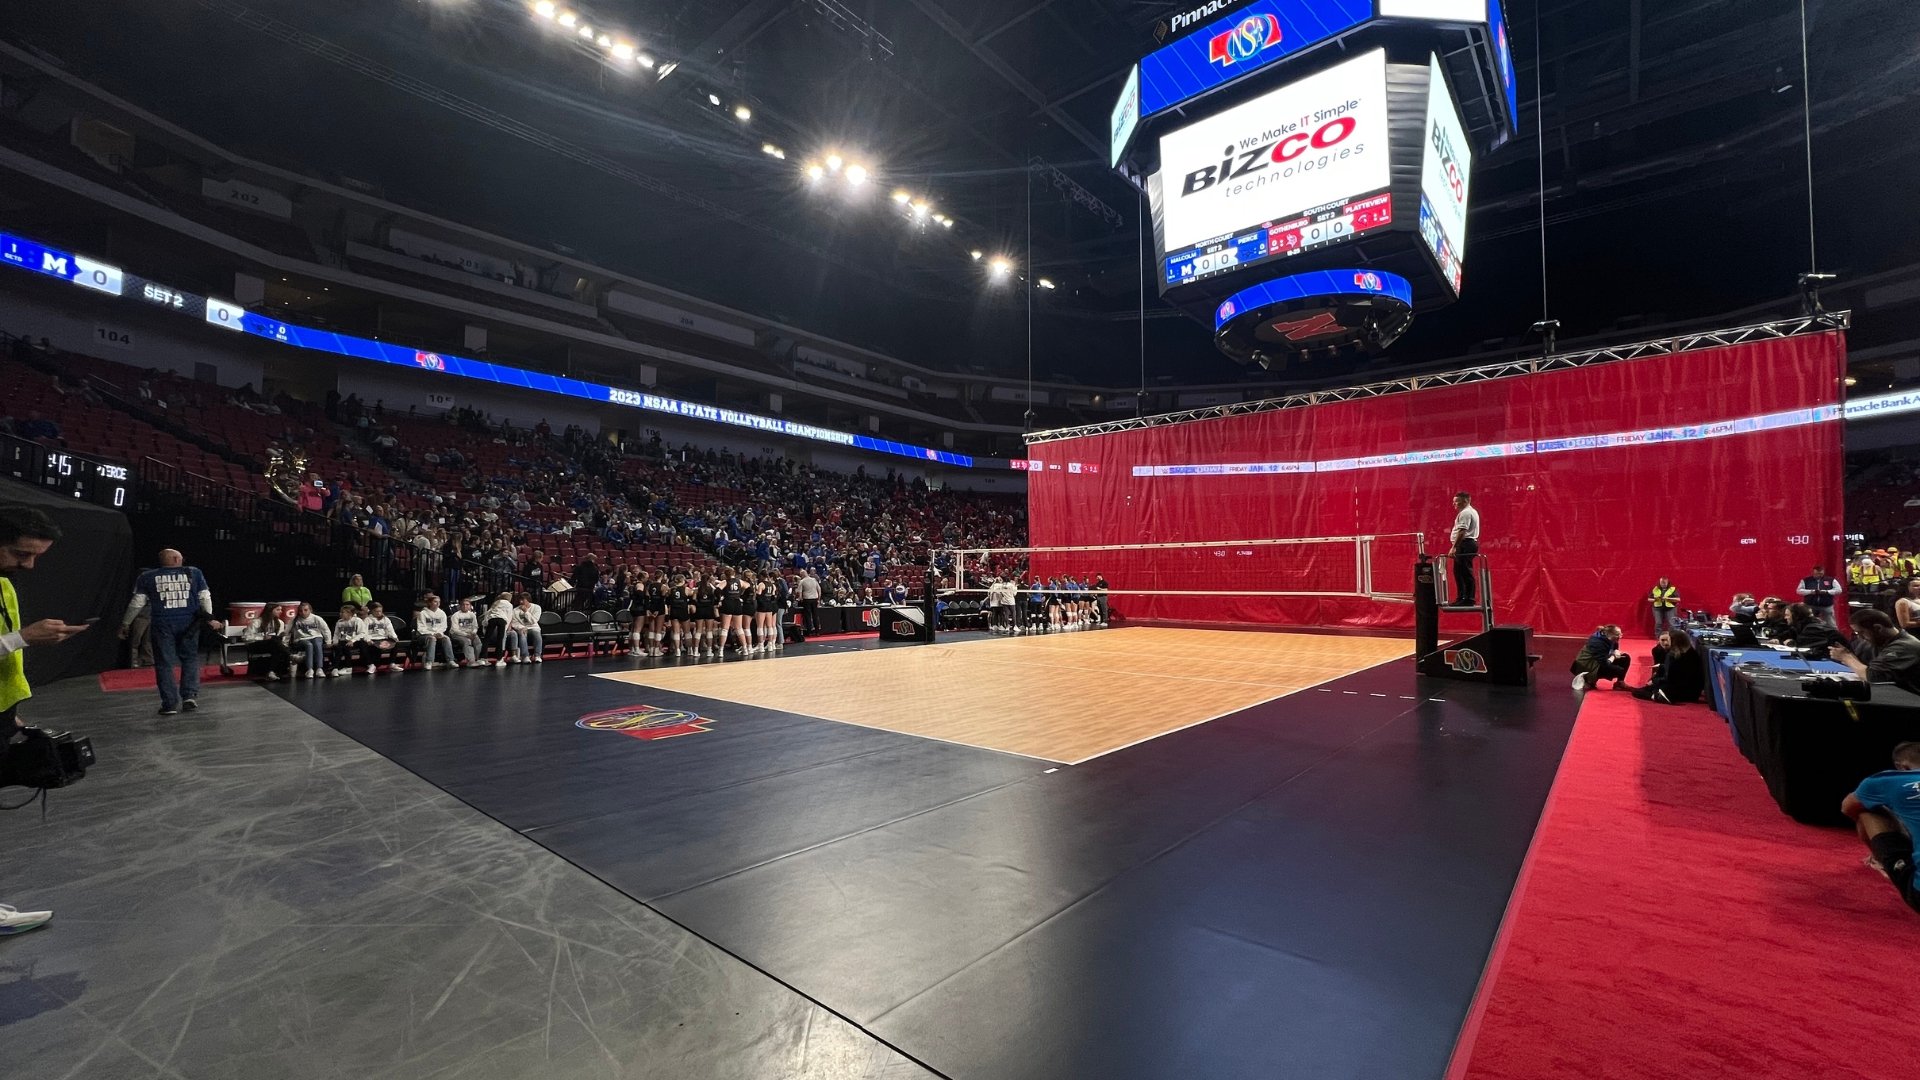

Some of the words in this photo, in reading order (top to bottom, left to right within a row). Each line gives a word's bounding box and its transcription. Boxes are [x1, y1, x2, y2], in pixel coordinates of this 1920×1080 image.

[1239, 137, 1258, 149] We
[1262, 122, 1297, 142] Make
[1300, 115, 1310, 128] IT
[1314, 99, 1359, 122] Simple
[1226, 142, 1365, 198] technologies
[232, 190, 259, 205] 202
[1303, 206, 1326, 217] SOUTH
[1326, 198, 1350, 211] COURT
[1345, 197, 1388, 214] PLATTEVIEW
[1317, 213, 1329, 222] SET
[1333, 221, 1343, 234] 0
[1215, 232, 1234, 243] COURT
[1238, 234, 1258, 245] PIERCE
[1311, 228, 1320, 240] 0
[12, 243, 17, 253] 1
[1207, 246, 1217, 254] SET
[43, 252, 68, 275] M
[1170, 252, 1197, 264] MALCOLM
[1221, 254, 1229, 265] 0
[1181, 264, 1192, 276] M
[1202, 259, 1210, 270] 0
[93, 270, 107, 285] 0
[144, 283, 172, 303] SET
[173, 293, 184, 307] 2
[217, 308, 229, 321] 0
[279, 326, 286, 334] 0
[97, 328, 130, 345] 104
[1881, 397, 1911, 408] Bank
[609, 389, 641, 406] 2023
[643, 395, 679, 413] NSAA
[681, 402, 718, 420] STATE
[719, 409, 784, 432] VOLLEYBALL
[785, 422, 854, 445] CHAMPIONSHIPS
[1616, 434, 1646, 444] FRIDAY
[1683, 429, 1697, 438] 12
[1703, 424, 1734, 435] 6:45PM
[114, 487, 125, 506] 0
[156, 583, 191, 592] SPORTS
[160, 591, 190, 600] PHOTO
[675, 591, 681, 599] 9
[164, 599, 187, 608] .COM
[244, 610, 255, 619] G
[286, 609, 295, 617] G
